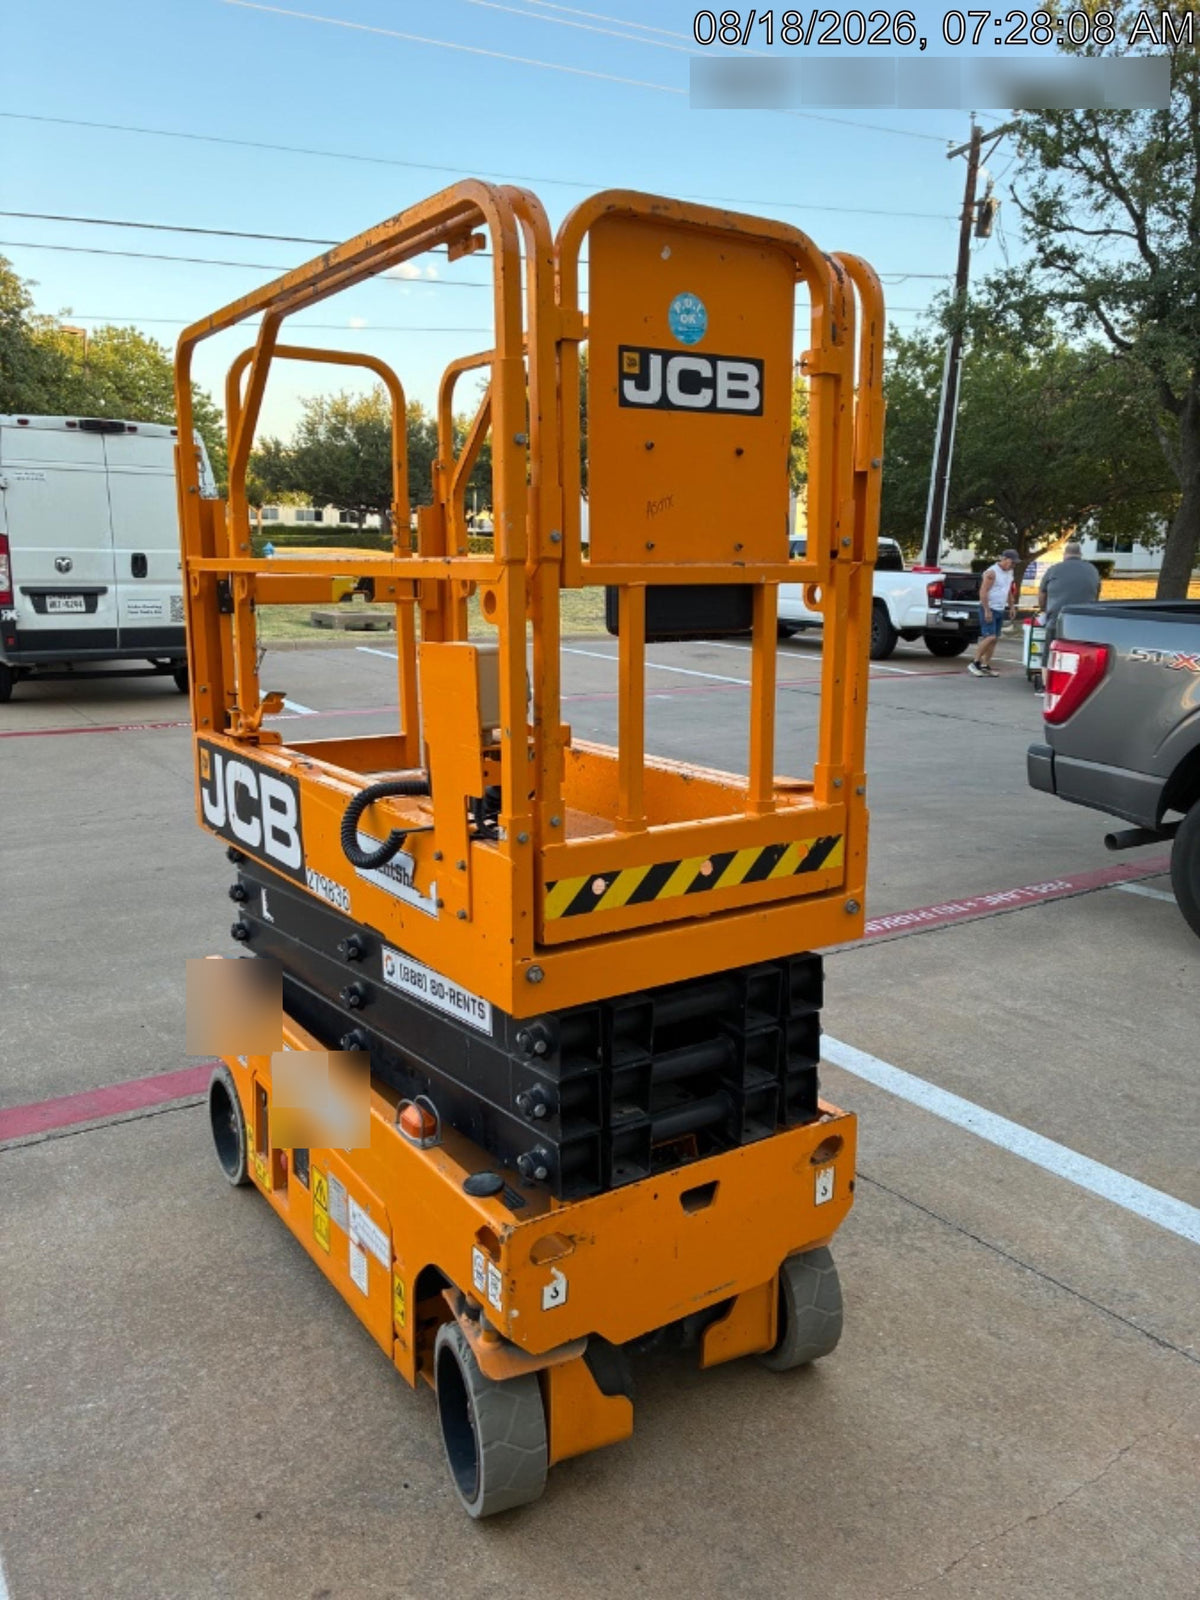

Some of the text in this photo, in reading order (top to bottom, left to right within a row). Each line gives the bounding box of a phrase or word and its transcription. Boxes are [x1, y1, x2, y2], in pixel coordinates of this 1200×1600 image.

[680, 313, 697, 324] OK
[622, 352, 761, 410] JCB
[1127, 646, 1200, 674] STX
[201, 752, 302, 871] JCB
[399, 962, 487, 1020] (888) 80-RENTS
